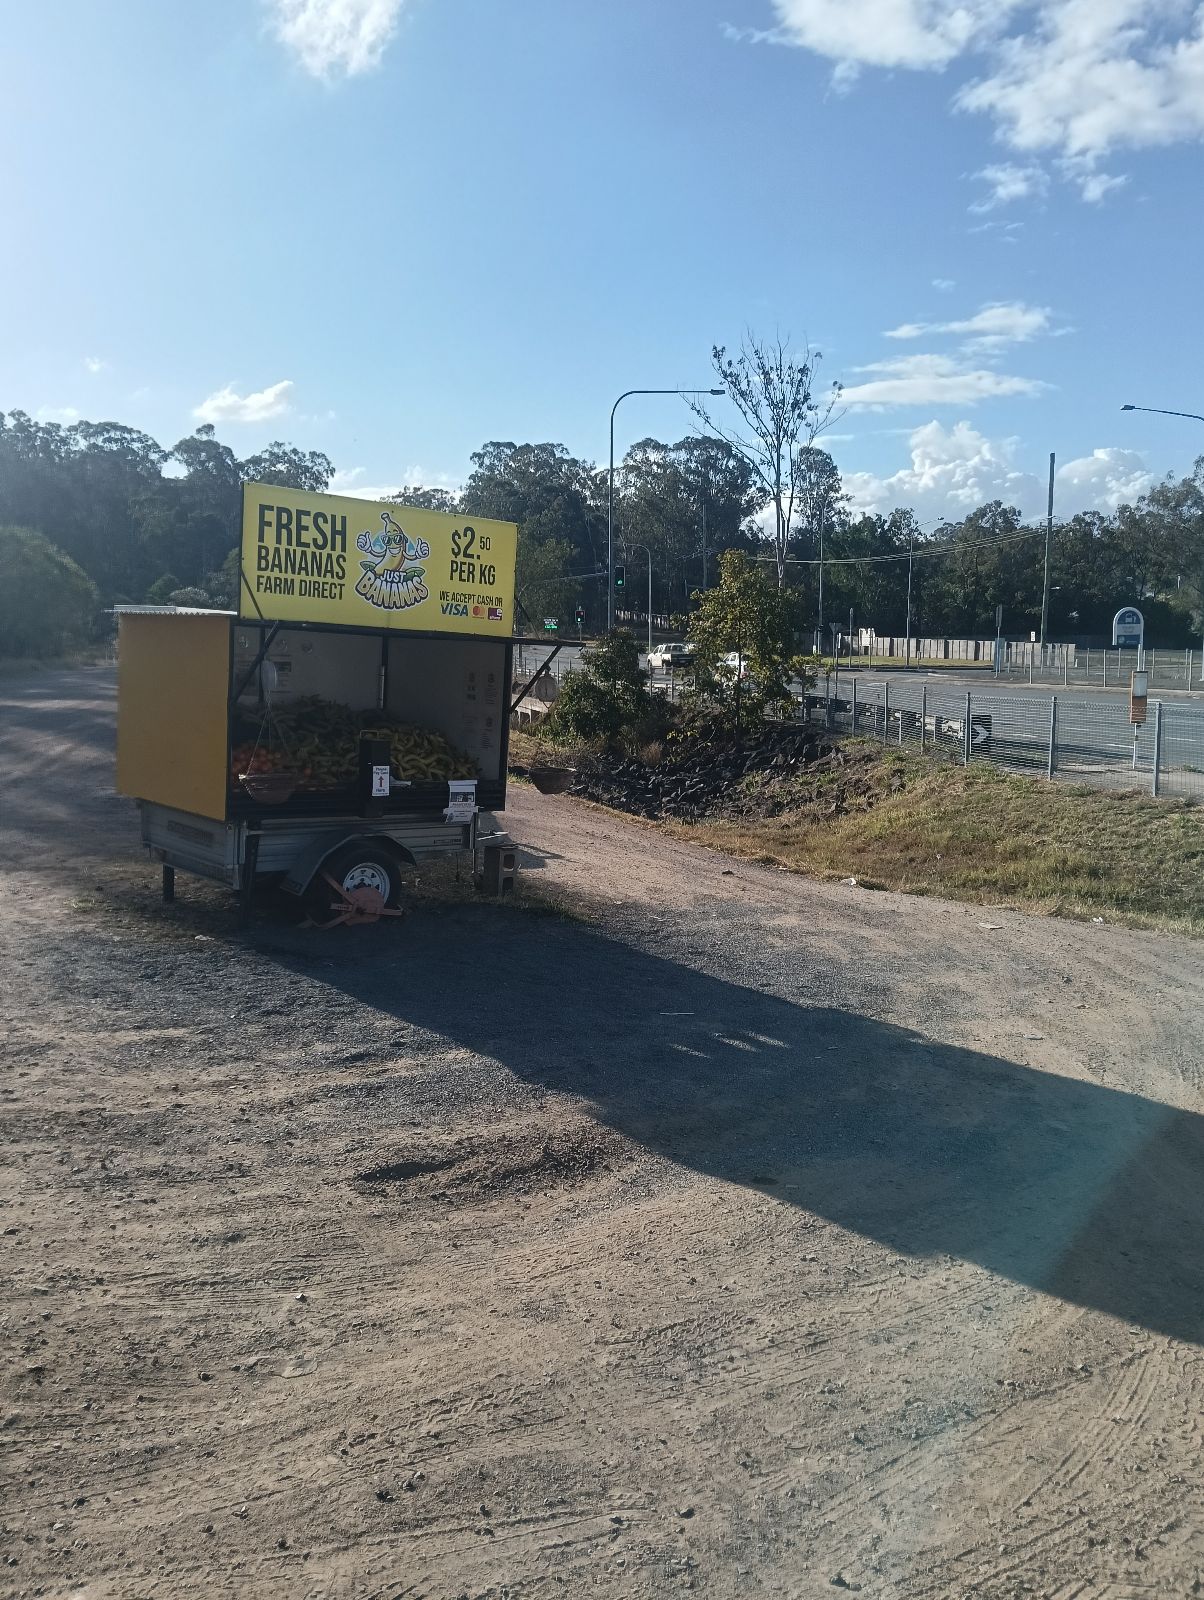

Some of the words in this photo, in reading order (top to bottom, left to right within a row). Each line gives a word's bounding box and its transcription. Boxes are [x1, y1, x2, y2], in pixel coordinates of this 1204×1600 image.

[258, 503, 347, 553] FRESH
[257, 544, 347, 580] BANANAS
[450, 560, 476, 583] PER
[479, 563, 496, 585] KG
[256, 575, 295, 595] FARM
[299, 579, 345, 600] DIRECT
[380, 569, 407, 582] JUST
[355, 570, 430, 609] BANANAS
[439, 590, 450, 601] WE
[451, 592, 476, 604] ACCEPT
[476, 595, 494, 606] CASH
[494, 597, 503, 607] OR
[441, 603, 469, 616] VISA
